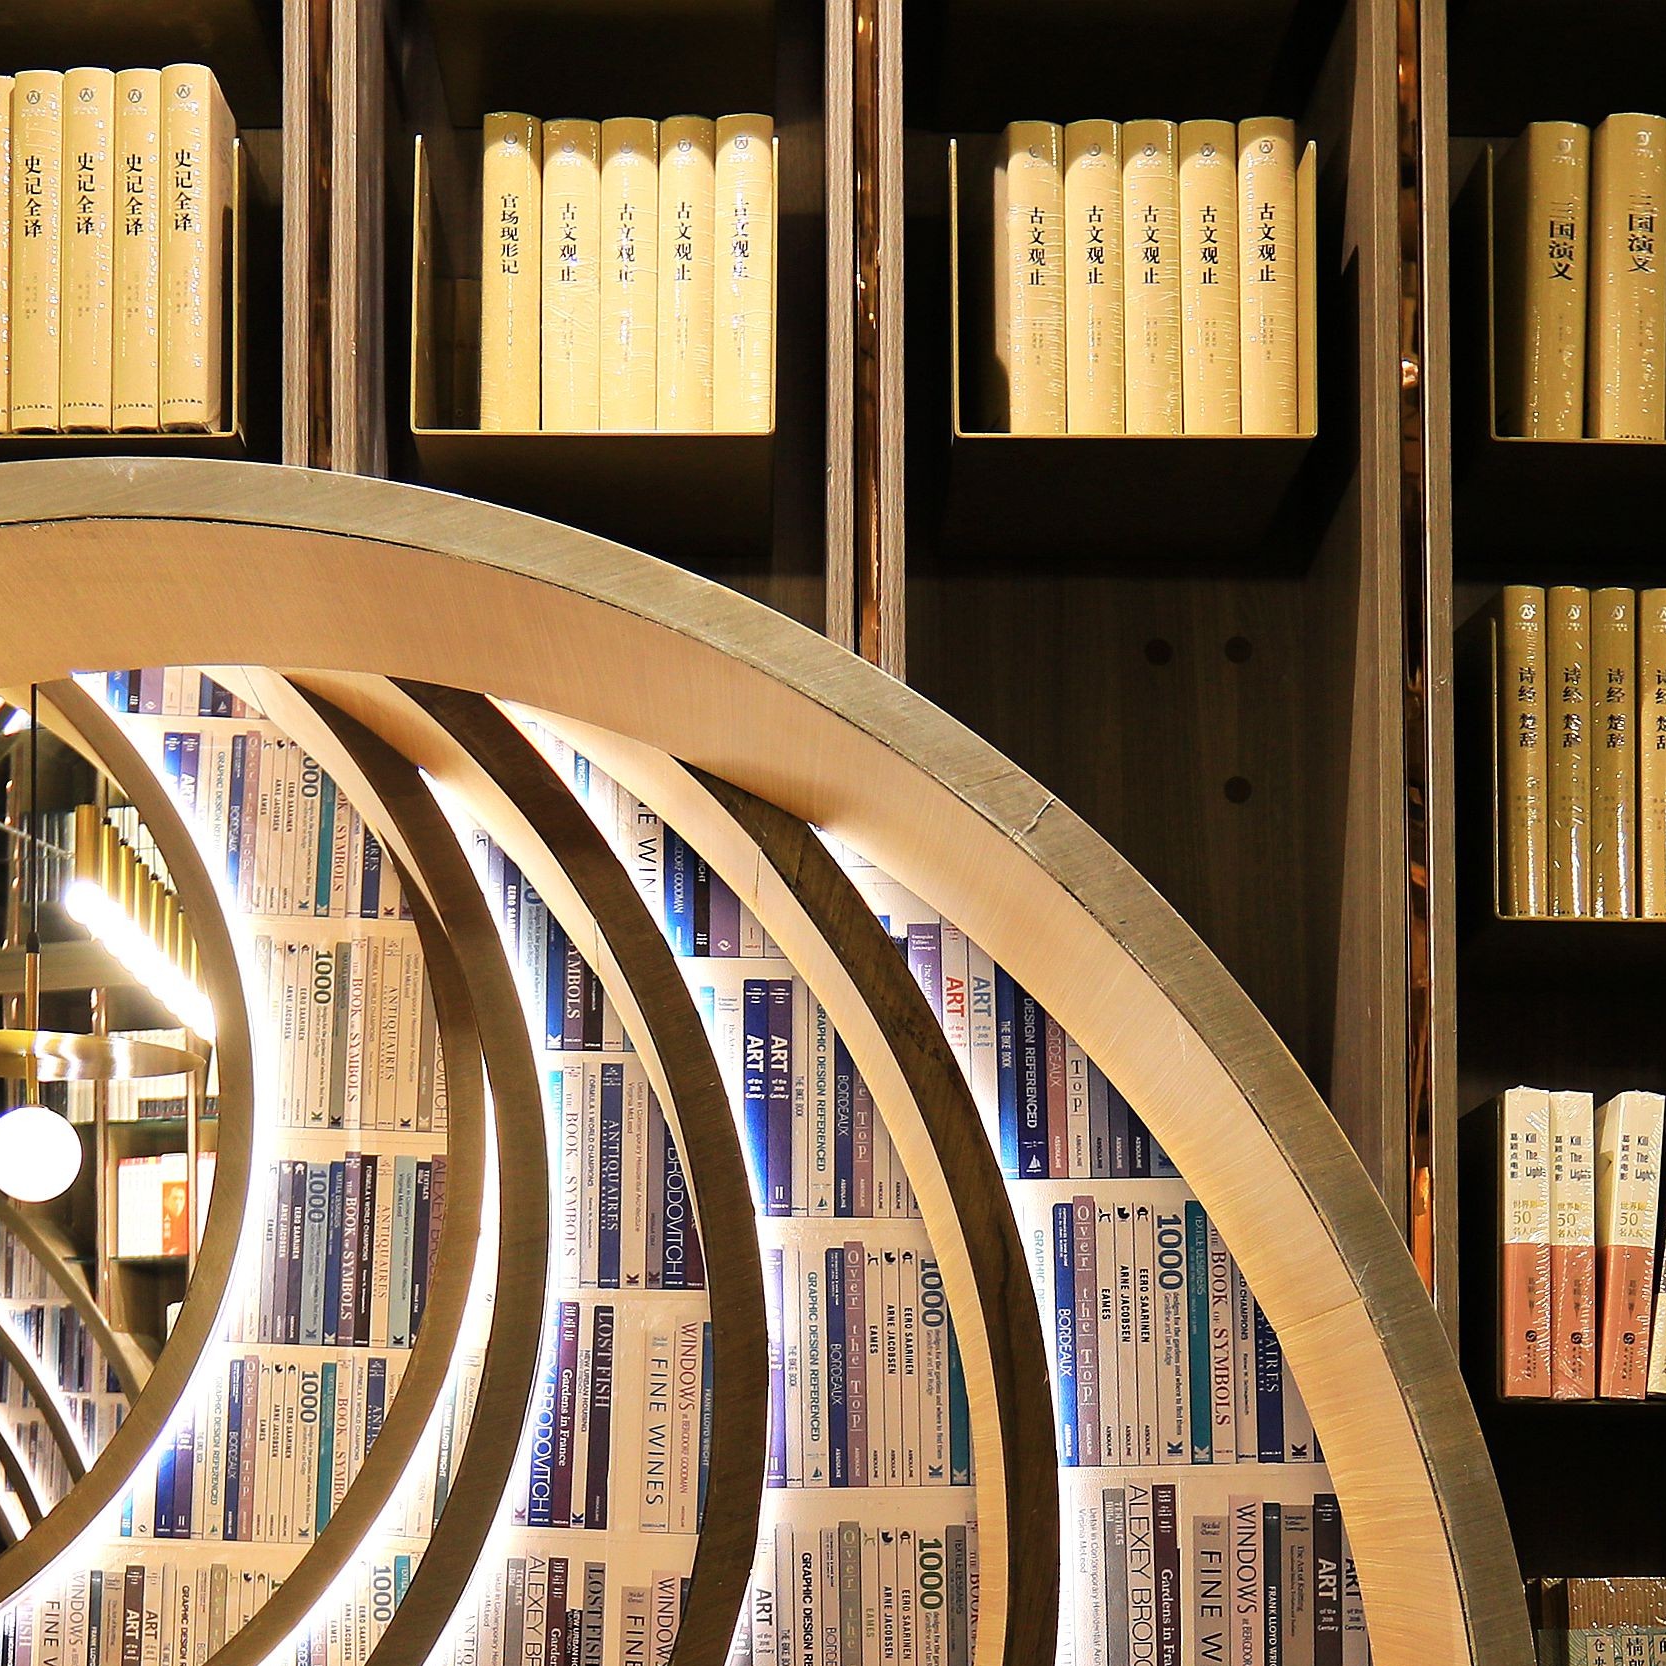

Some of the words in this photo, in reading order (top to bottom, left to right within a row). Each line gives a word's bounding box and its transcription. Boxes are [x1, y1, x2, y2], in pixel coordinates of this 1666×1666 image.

[75, 152, 95, 235] 史记全译
[174, 149, 193, 232] 史记全译
[500, 194, 519, 274] 官场现形记
[559, 203, 577, 282] 古文观止
[673, 202, 693, 282] 古文观止
[1027, 206, 1046, 286] 古文观止
[1141, 205, 1160, 285] 古文观止
[1258, 203, 1277, 282] 古文观止
[1549, 200, 1575, 282] 三国演义
[946, 976, 965, 1017] ART
[746, 1034, 765, 1073] ART
[1525, 1133, 1537, 1144] Kill
[1525, 1150, 1539, 1161] The
[1570, 1136, 1582, 1146] Kill
[1570, 1153, 1582, 1163] The
[1513, 1212, 1531, 1224] 50
[1557, 1213, 1576, 1226] 50
[1120, 1265, 1129, 1290] ARNE
[1157, 1214, 1183, 1290] 1000
[1101, 1288, 1111, 1320] EAMES
[1140, 1269, 1149, 1292] EERO
[1212, 1251, 1227, 1306] BOOK
[1058, 1309, 1072, 1376] BORDEAUX
[1121, 1295, 1131, 1343] JACOBSEN
[1141, 1296, 1150, 1343] SAARINEN
[1213, 1328, 1230, 1425] SYMBOLS
[1129, 1484, 1151, 1580] ALEXEY
[919, 1538, 943, 1610] 1000
[1200, 1550, 1223, 1617] FINE
[1236, 1503, 1257, 1614] WINDOWS
[1318, 1558, 1337, 1600] ART
[1161, 1568, 1174, 1624] Gardens
[1268, 1586, 1277, 1611] FRANK
[44, 1601, 60, 1647] FINE
[1163, 1628, 1174, 1640] in
[1269, 1614, 1277, 1644] LLOYD
